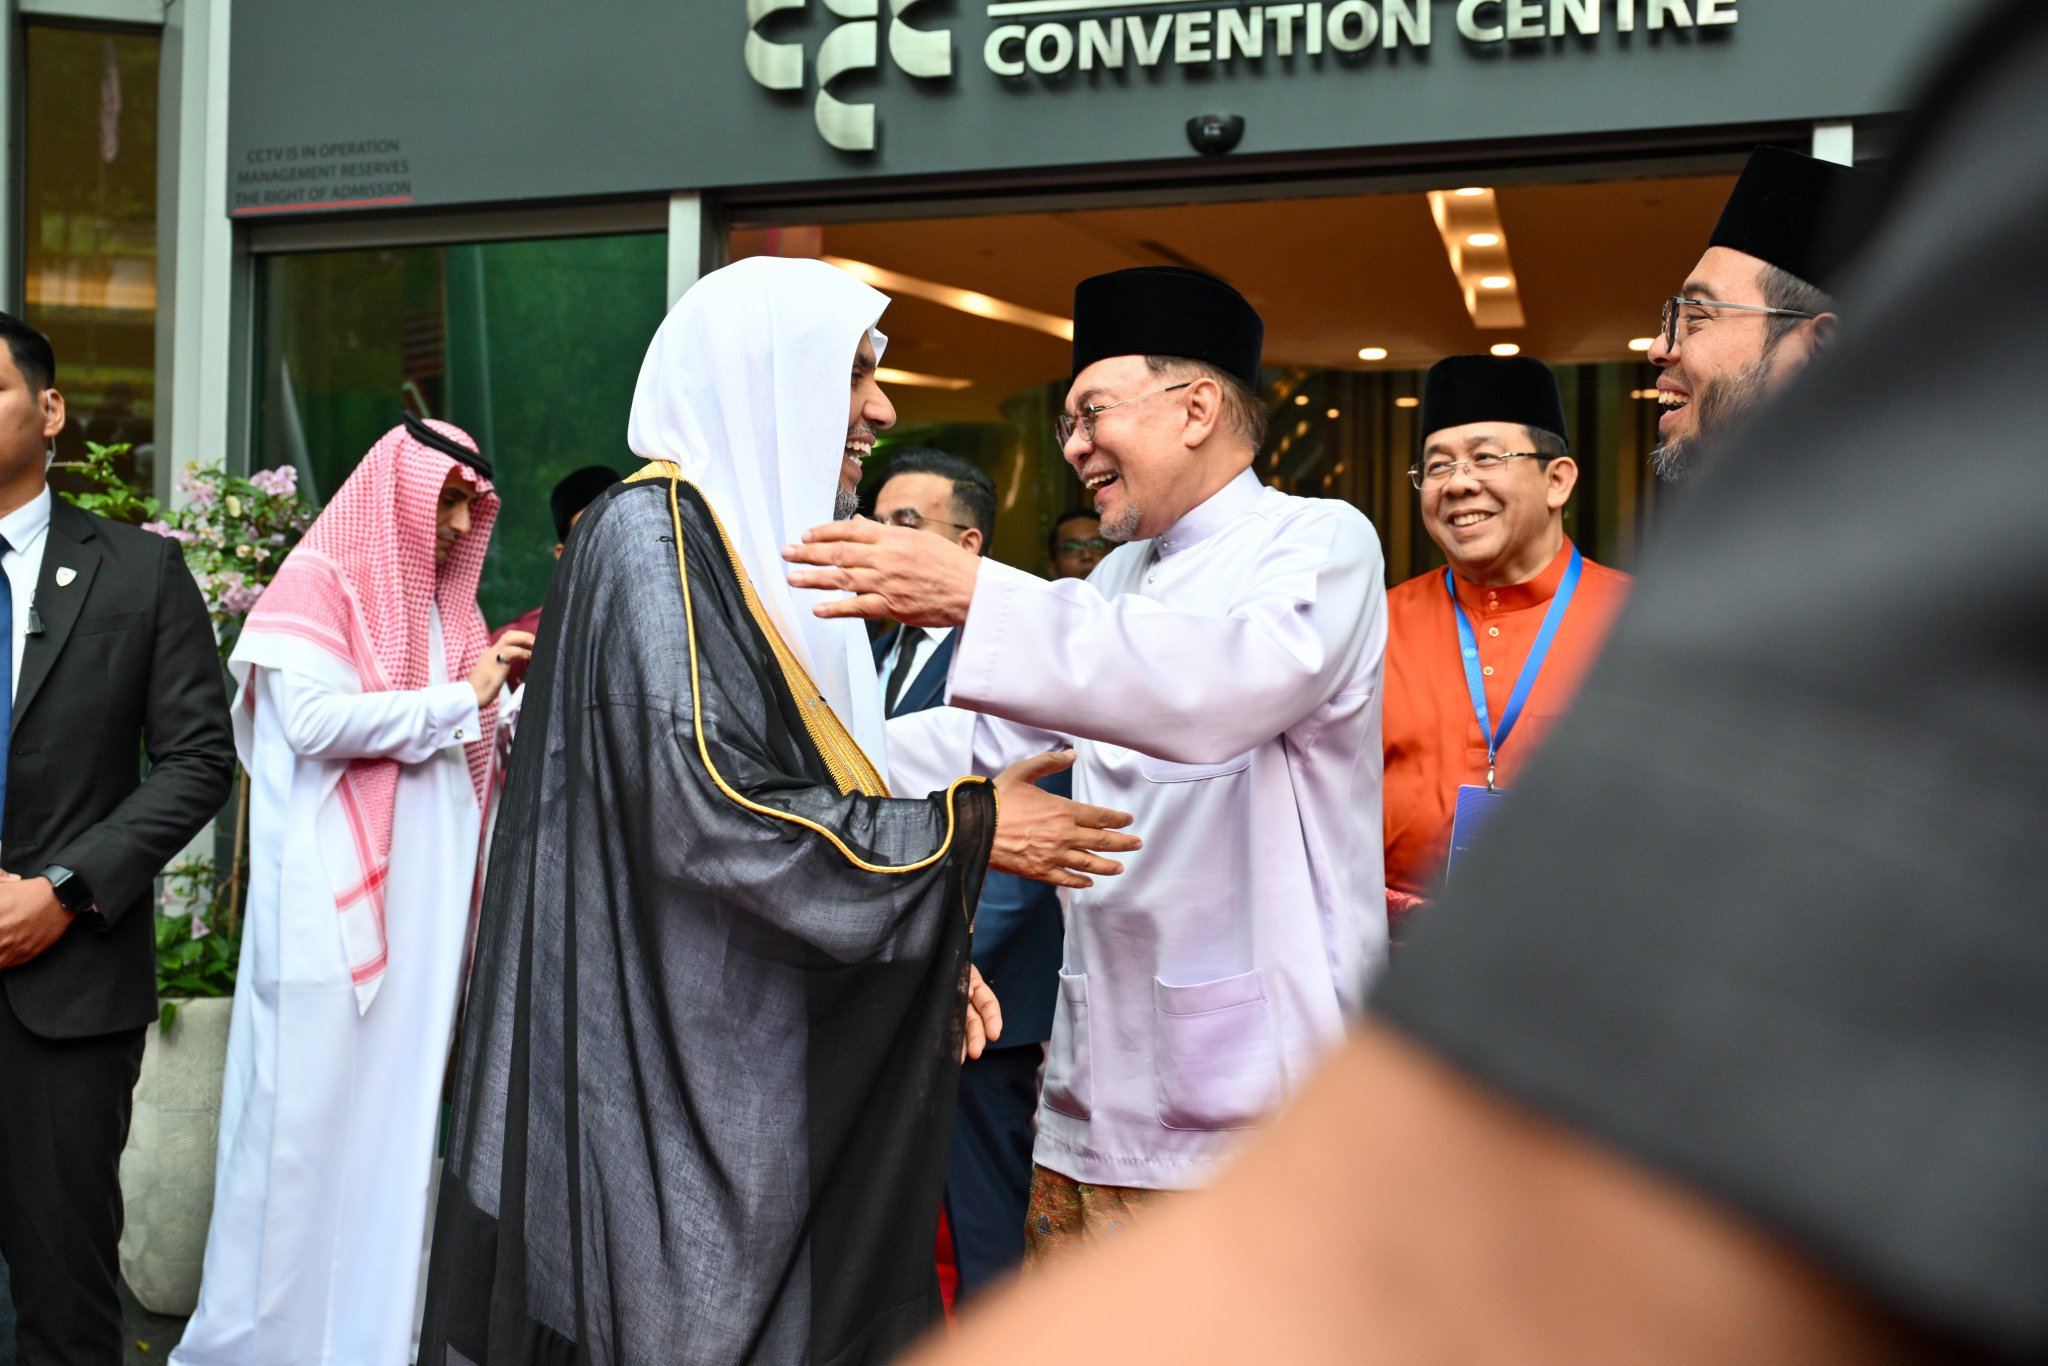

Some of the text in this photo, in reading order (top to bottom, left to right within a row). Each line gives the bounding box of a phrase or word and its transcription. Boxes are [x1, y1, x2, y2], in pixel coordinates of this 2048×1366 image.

[983, 0, 1431, 76] CONVENTION
[246, 139, 399, 164] CCTV IS IN OPERATION
[237, 159, 409, 184] MANAGEMENT RESERVES
[236, 181, 412, 206] THE RIGHT OF ADMISSION
